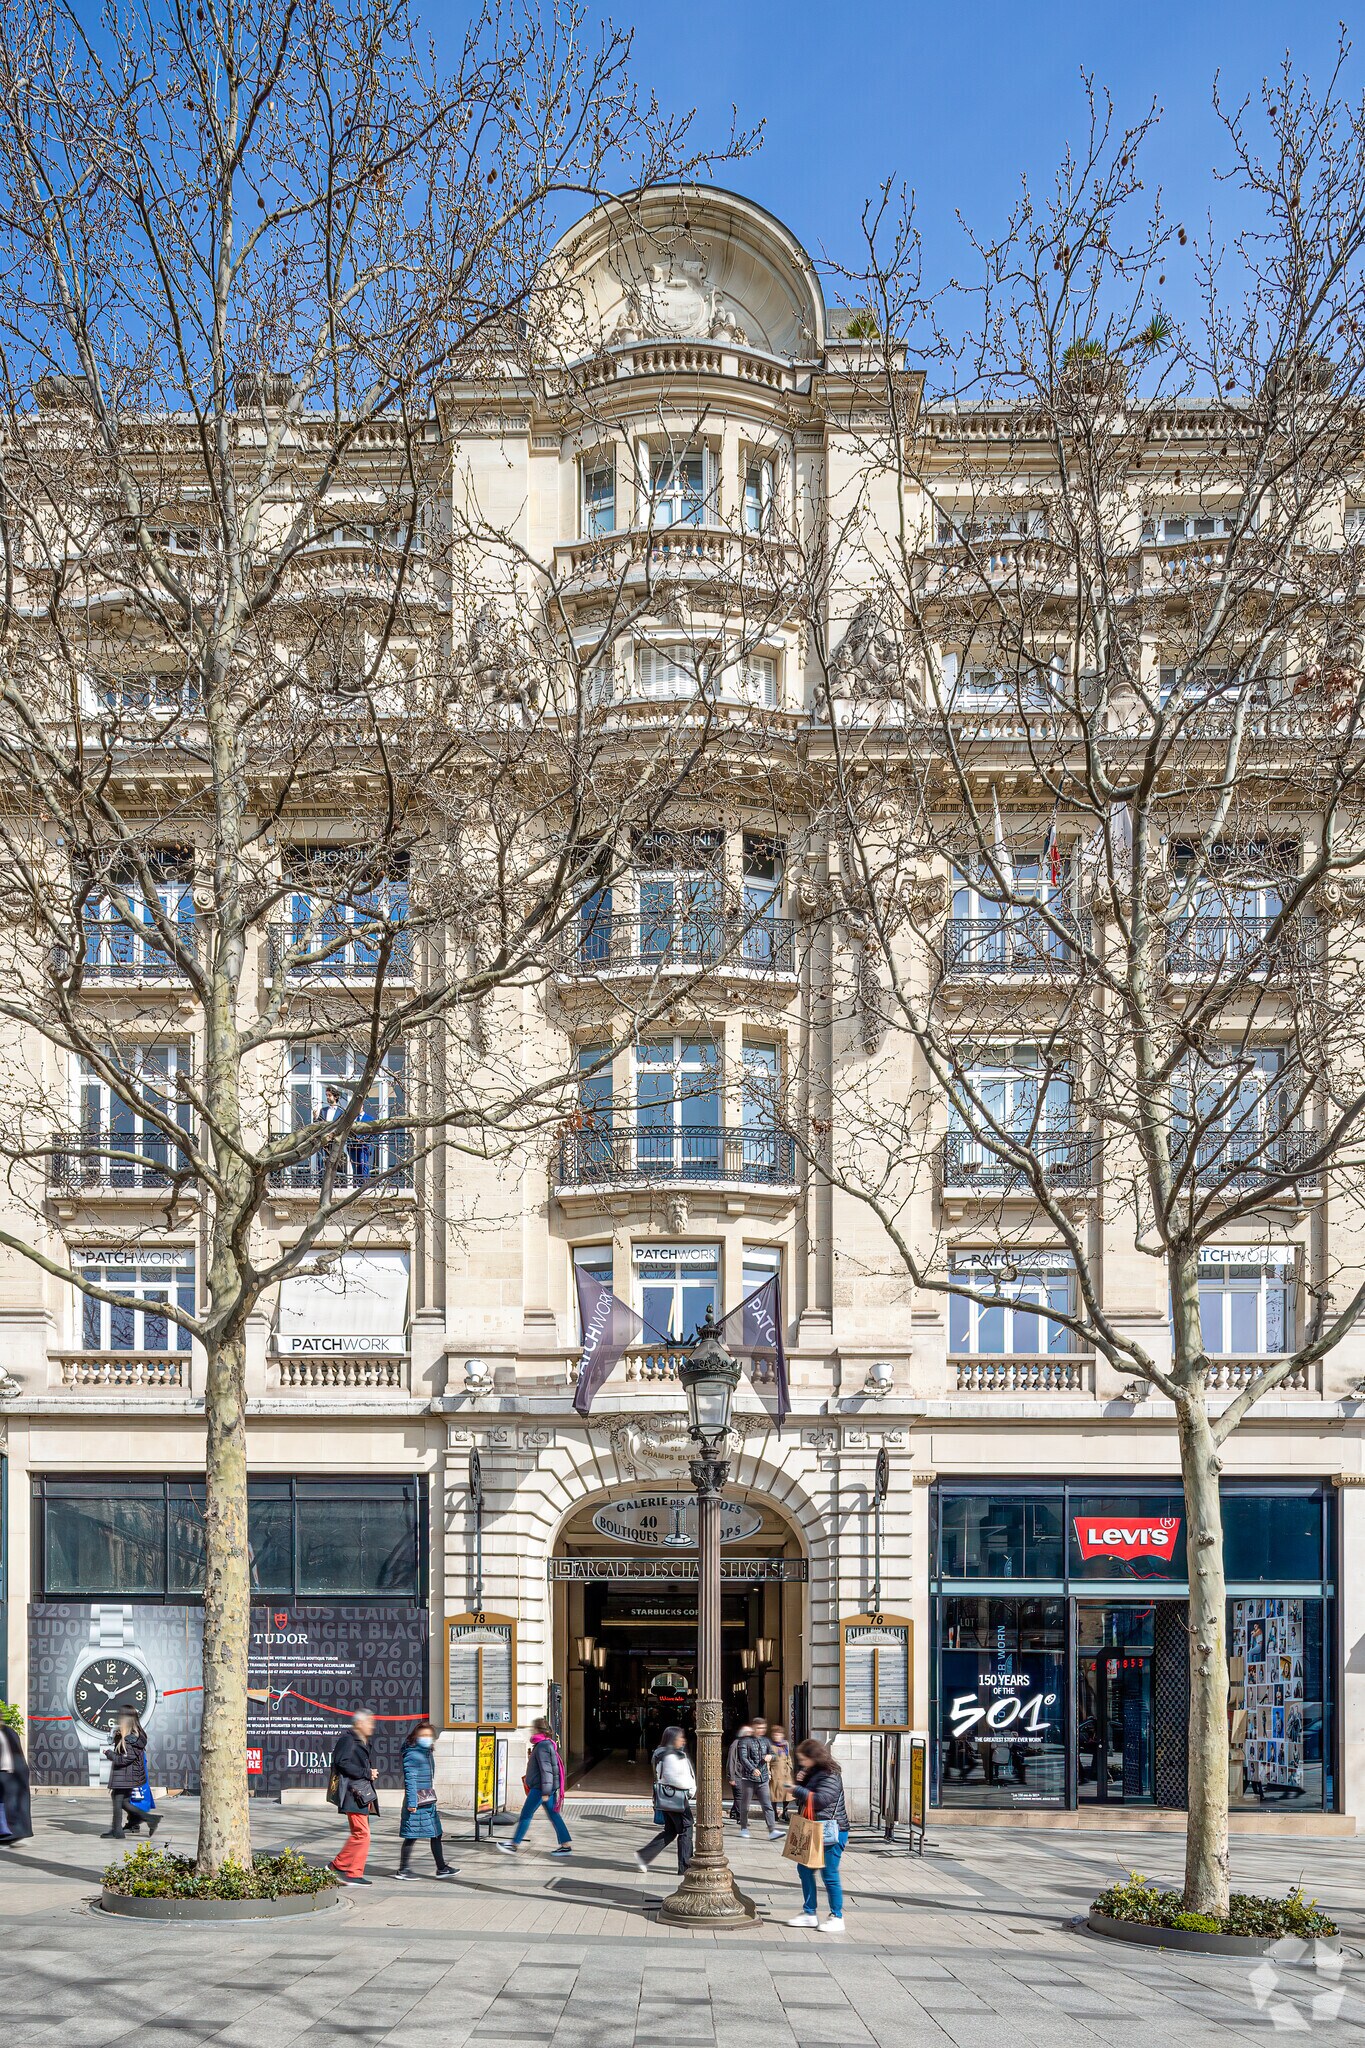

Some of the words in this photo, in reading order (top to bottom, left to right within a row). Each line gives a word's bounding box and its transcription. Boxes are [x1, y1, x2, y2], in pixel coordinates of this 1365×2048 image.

[86, 1252, 183, 1265] PATCHWORK
[636, 1249, 716, 1260] PATCHWORK
[972, 1254, 1069, 1266] PATCHWORK
[1199, 1250, 1278, 1262] TCHWORK
[578, 1288, 613, 1377] ATCHWORK
[292, 1338, 389, 1351] PATCHWORK
[642, 1449, 674, 1461] CHAMPS
[678, 1453, 701, 1461] ELYSE
[616, 1497, 668, 1513] GALERIE
[640, 1516, 658, 1528] 40
[600, 1516, 658, 1543] BOUTIQUES
[577, 1561, 640, 1578] ARCADES
[643, 1561, 668, 1578] DES
[670, 1561, 726, 1578] CHAS
[631, 1608, 682, 1616] STARBUCKS
[472, 1613, 486, 1624] 78
[870, 1614, 884, 1625] 76
[253, 1633, 309, 1645] TUDOR
[356, 1641, 402, 1659] 1926
[106, 1663, 116, 1674] 12
[978, 1674, 997, 1686] 150
[997, 1674, 1030, 1686] YEARS
[80, 1691, 87, 1700] 9
[135, 1691, 143, 1701] 3
[993, 1687, 1001, 1695] OF
[1002, 1687, 1015, 1695] THE
[108, 1718, 116, 1728] 6
[253, 1735, 324, 1753] TUDOR
